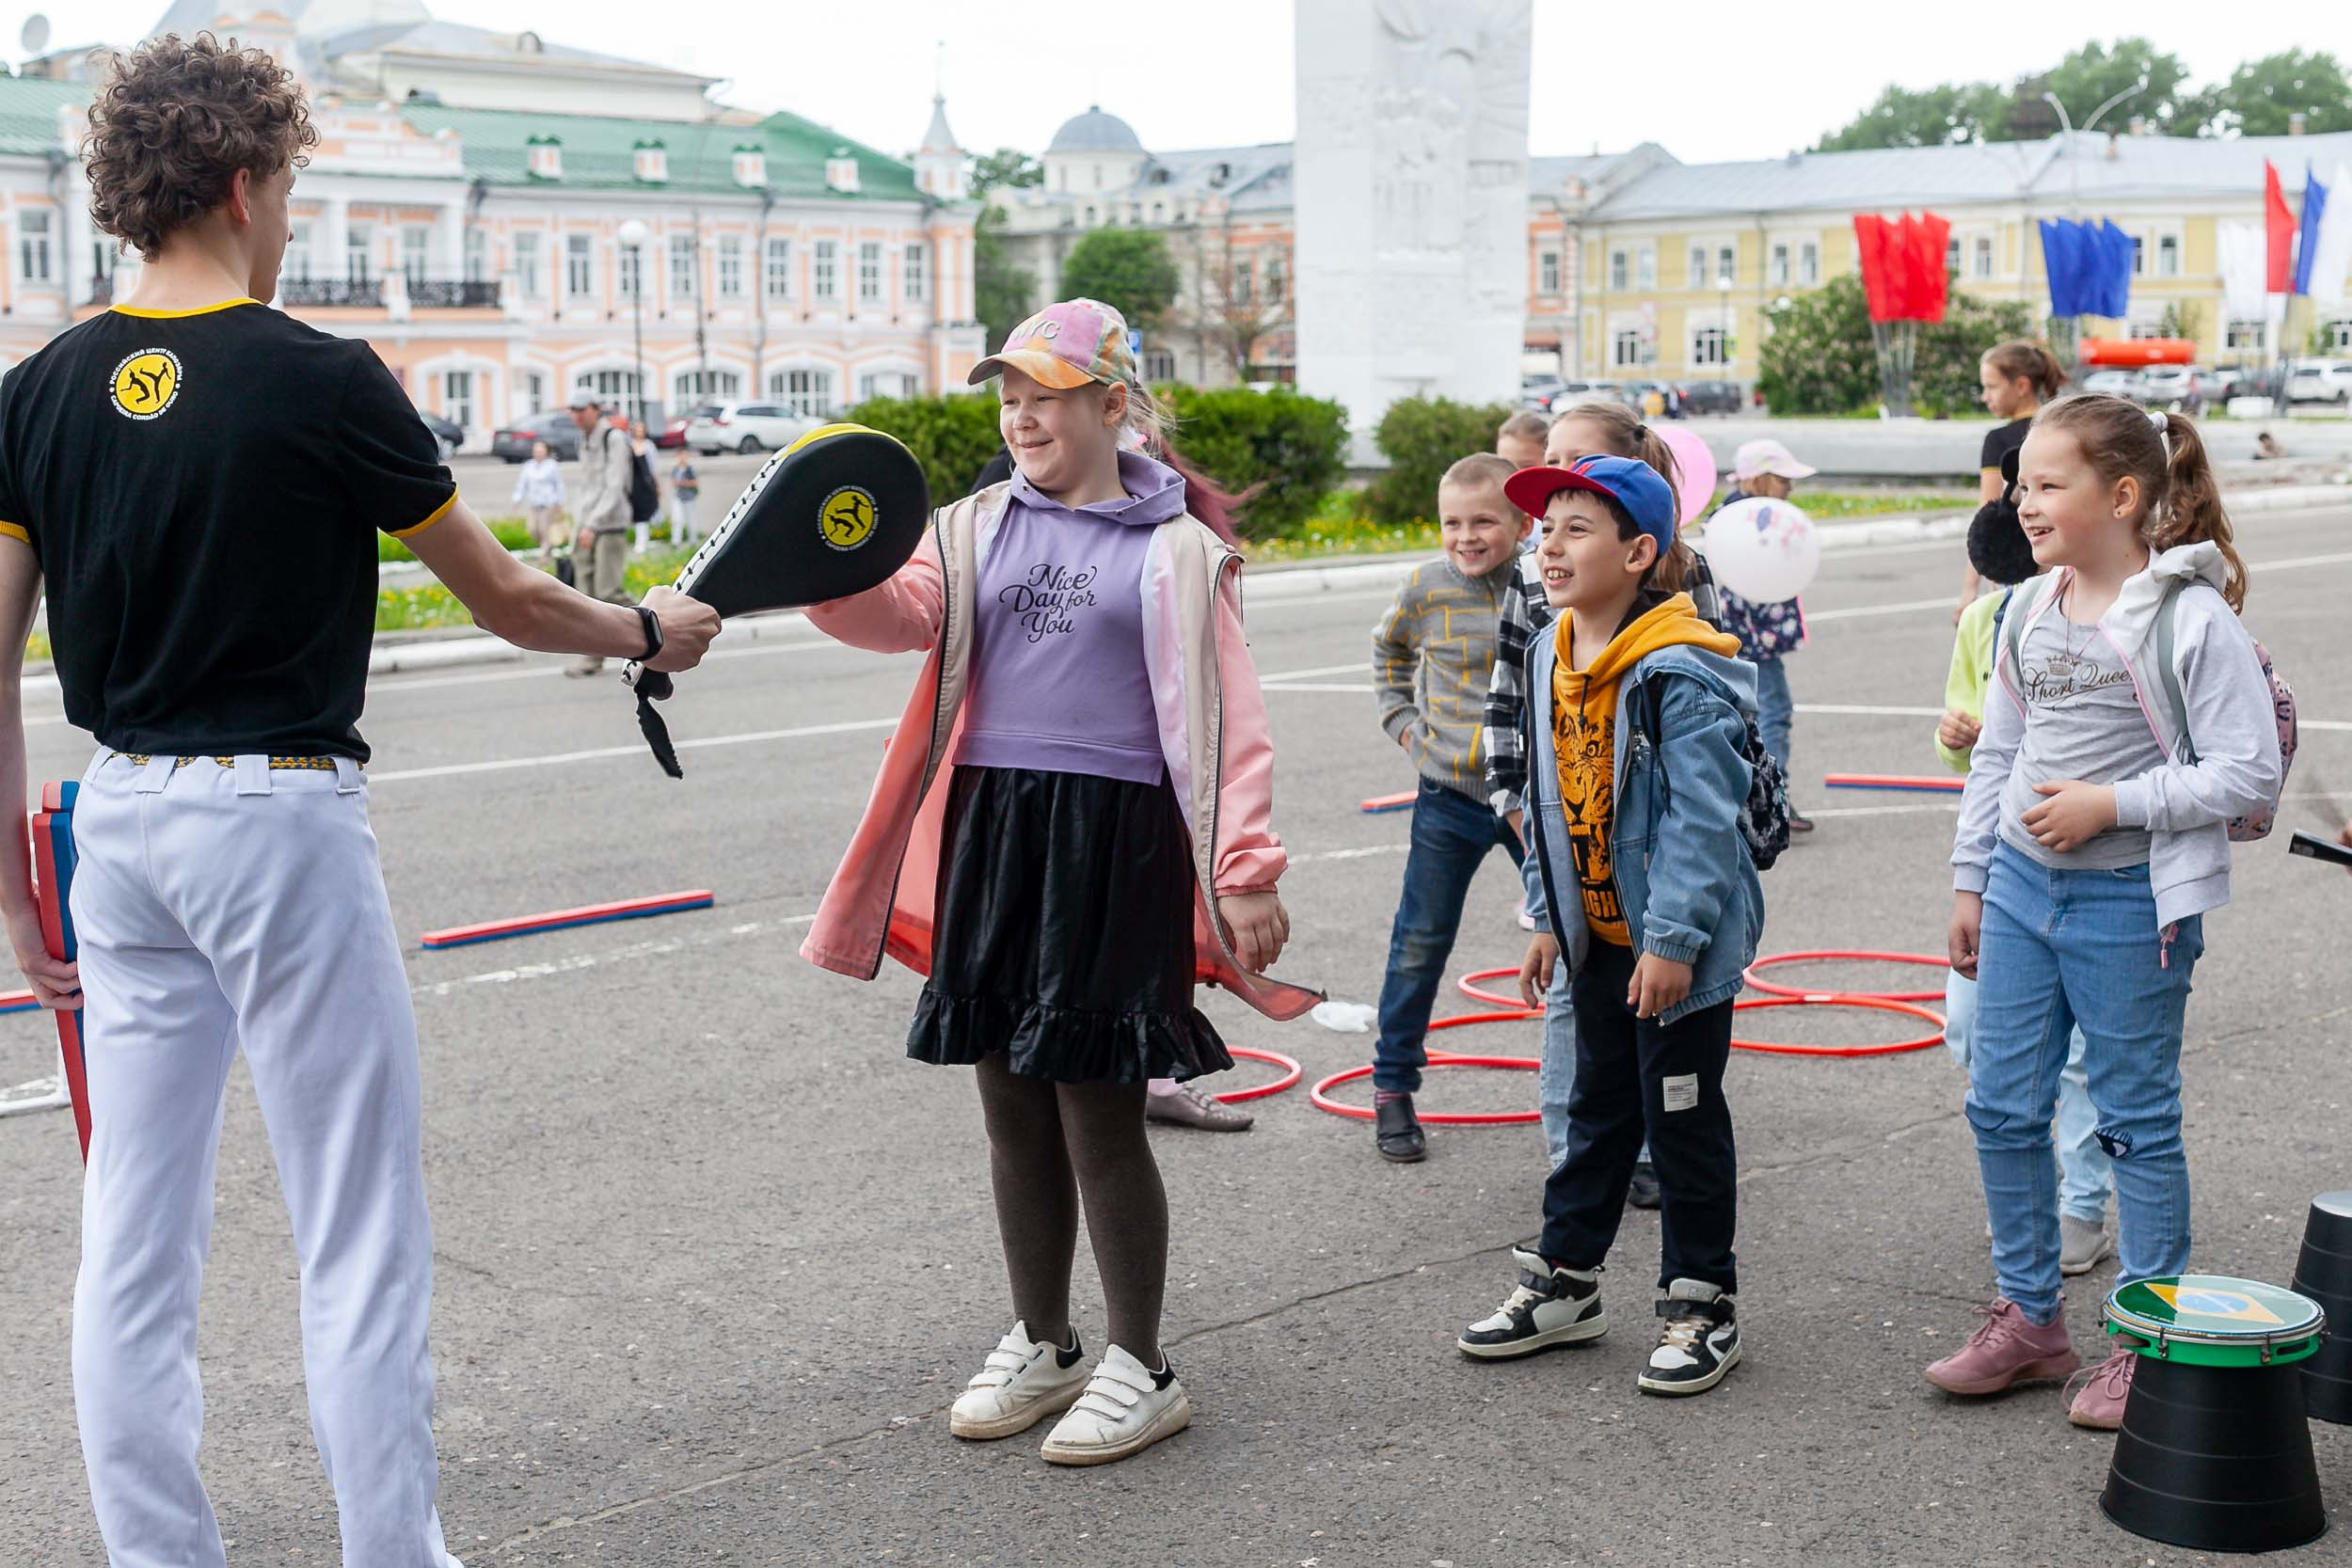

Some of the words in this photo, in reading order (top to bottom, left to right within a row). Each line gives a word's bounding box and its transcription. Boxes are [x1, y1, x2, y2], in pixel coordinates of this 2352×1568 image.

[1027, 563, 1097, 592] Nice
[999, 584, 1064, 619] Day
[1064, 590, 1098, 611] for
[1021, 611, 1075, 643] You
[2079, 662, 2134, 689] Quee
